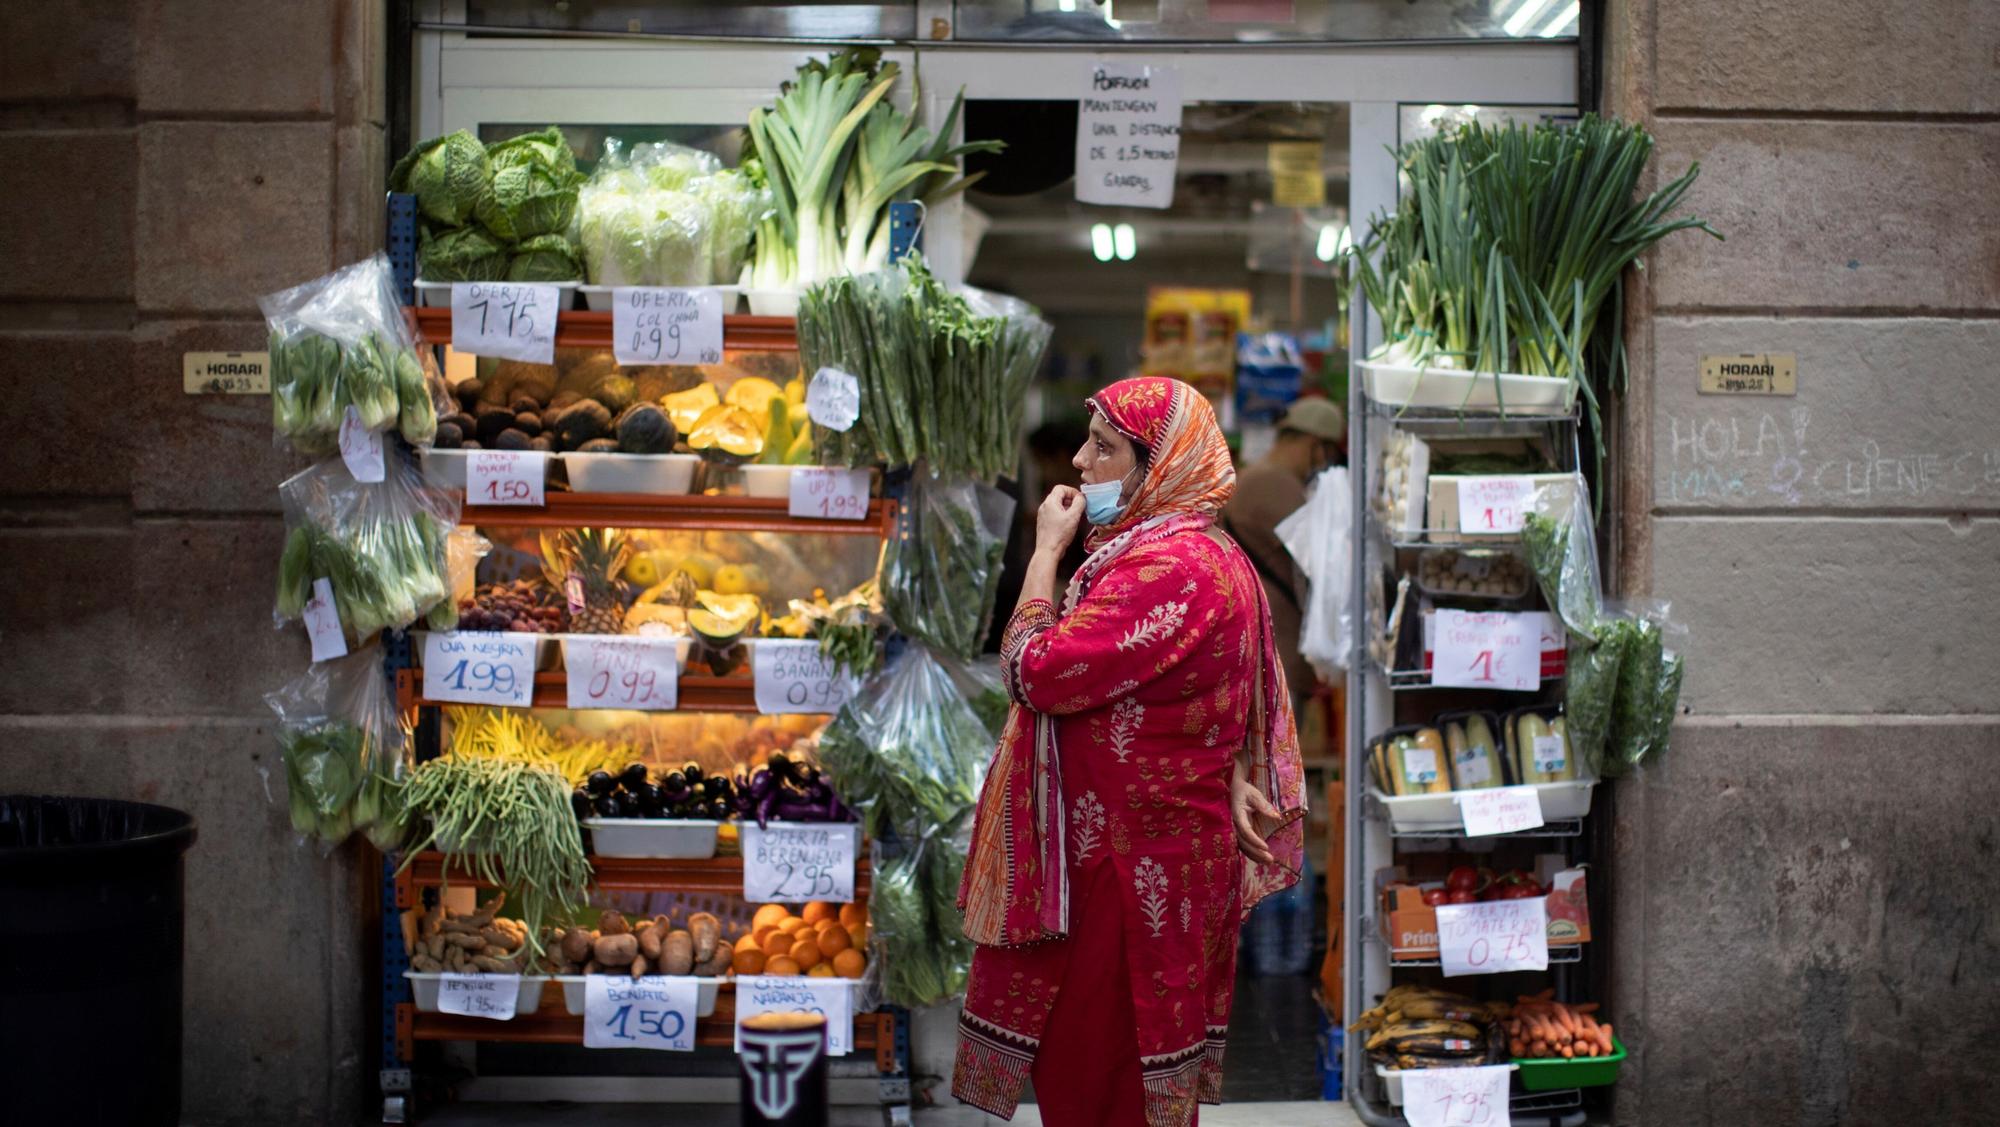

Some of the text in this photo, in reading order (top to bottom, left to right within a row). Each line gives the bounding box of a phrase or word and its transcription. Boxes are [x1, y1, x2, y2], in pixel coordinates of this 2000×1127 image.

[1090, 147, 1106, 160] DE
[470, 284, 536, 302] OFERTA
[631, 291, 697, 309] OFERTA
[632, 323, 681, 360] 0.99
[207, 363, 262, 375] HORARI
[1720, 363, 1774, 376] HORARI
[442, 659, 515, 694] 1.99
[773, 662, 832, 680] BANAN
[588, 669, 656, 703] 0.99
[763, 830, 829, 846] OFERTA
[769, 859, 835, 898] 2.95
[608, 988, 670, 1003] BONIATO
[752, 991, 816, 1005] NARANJA
[606, 1004, 685, 1040] 1.50
